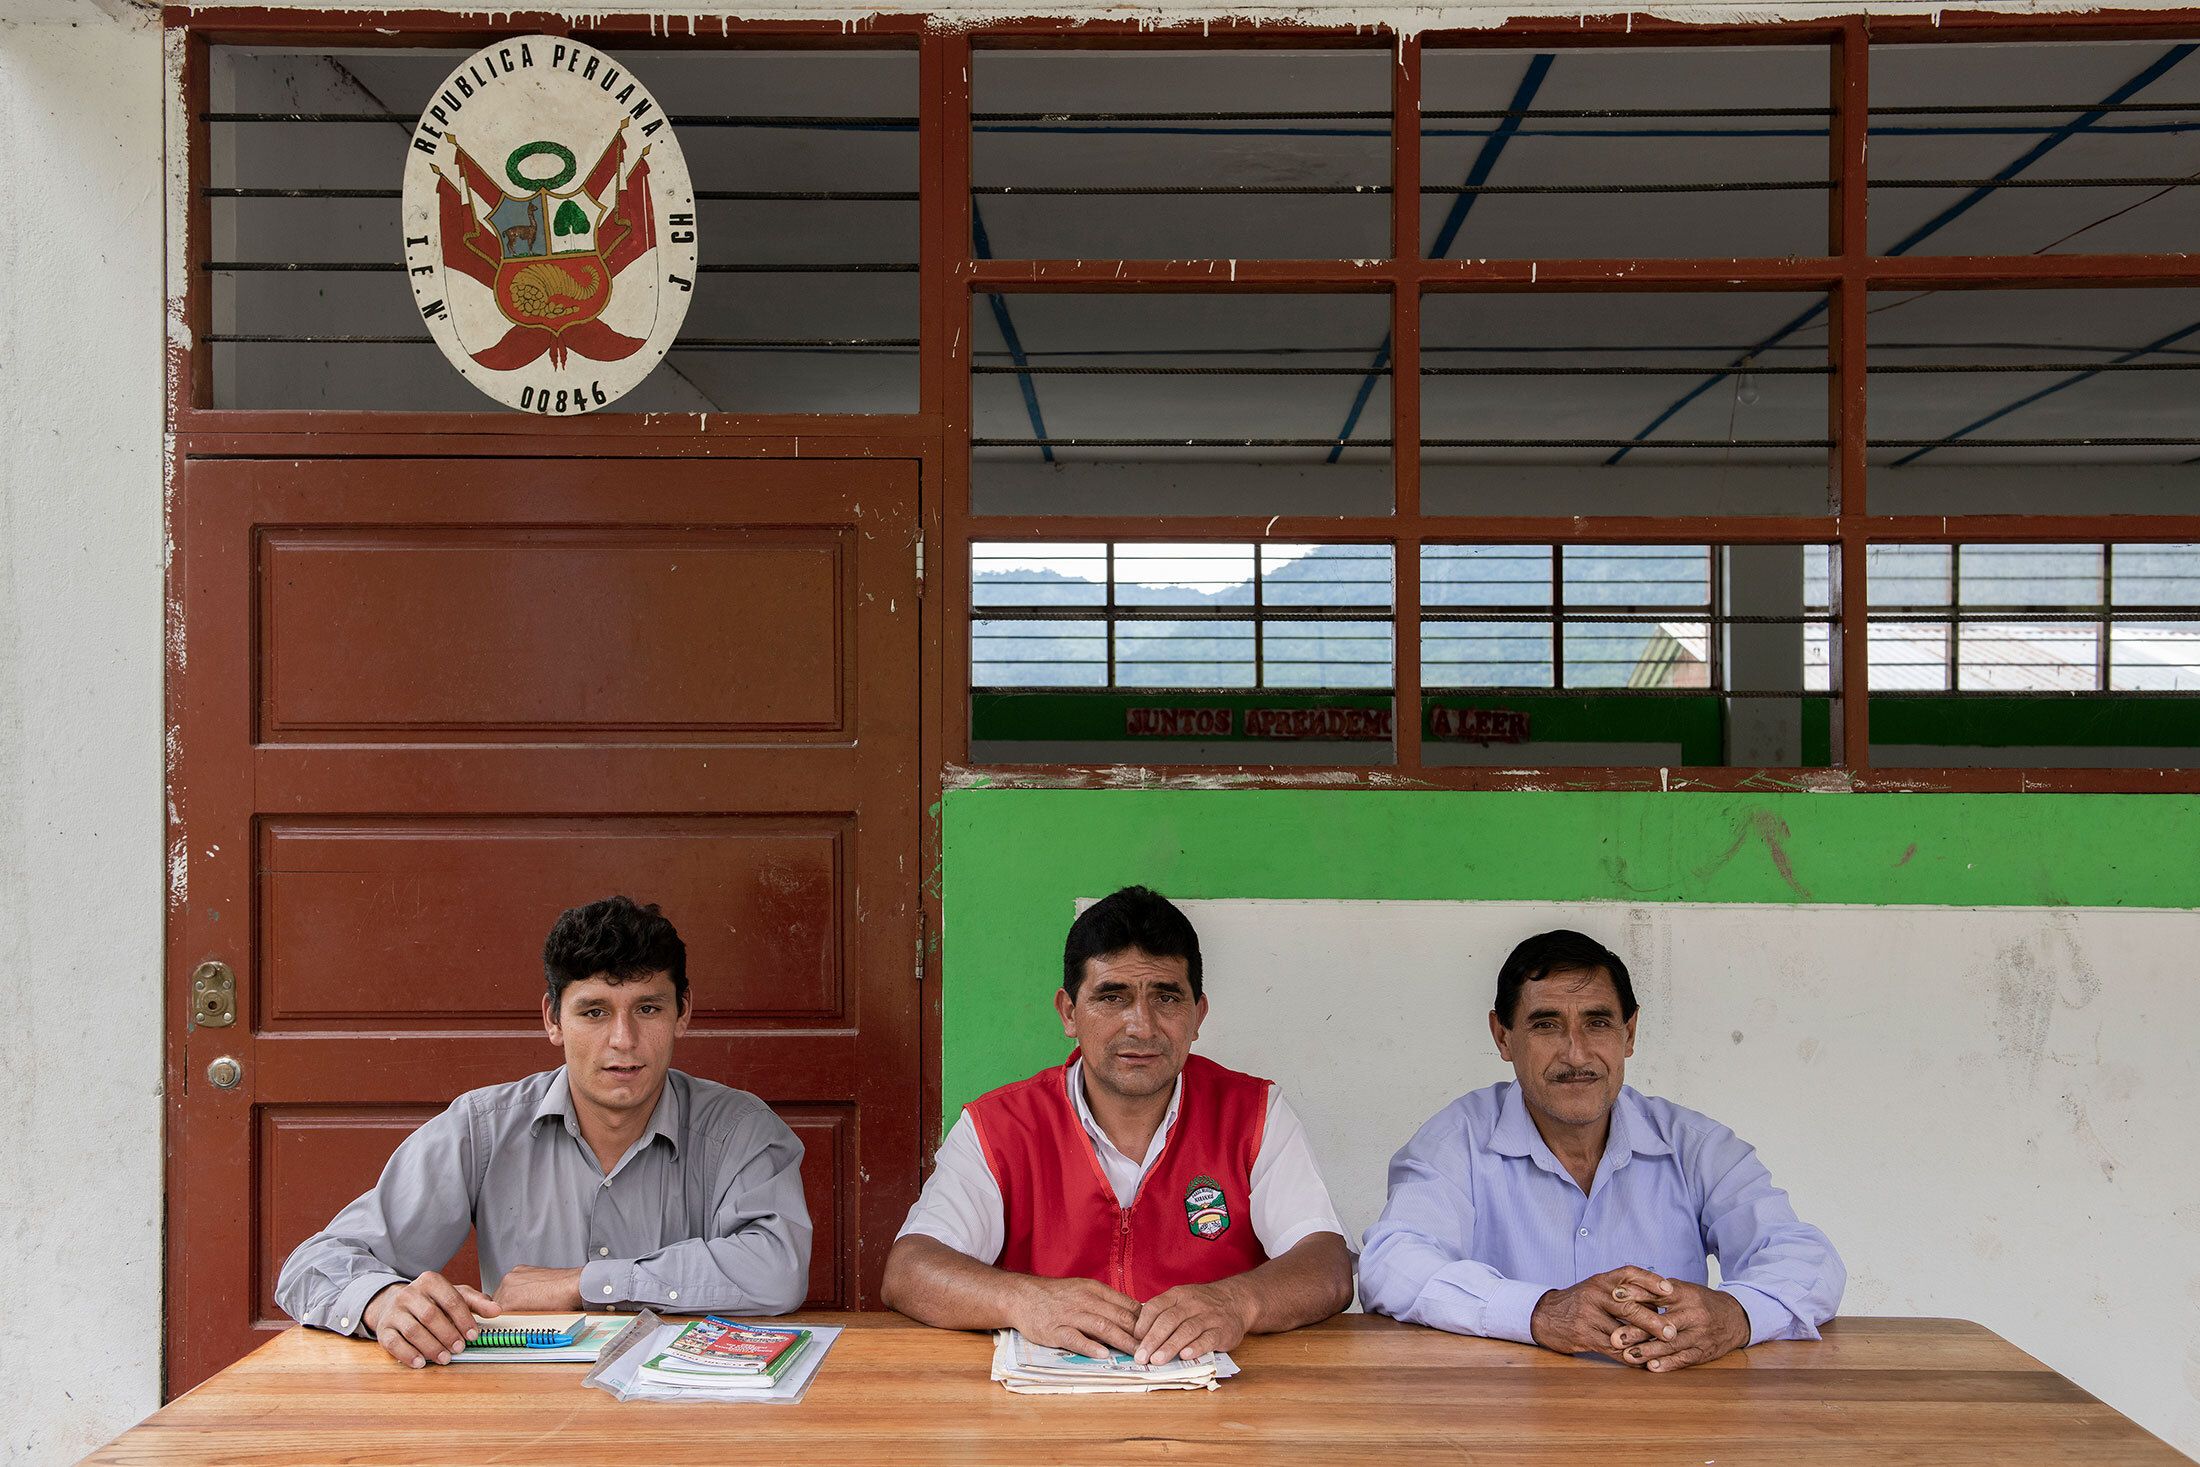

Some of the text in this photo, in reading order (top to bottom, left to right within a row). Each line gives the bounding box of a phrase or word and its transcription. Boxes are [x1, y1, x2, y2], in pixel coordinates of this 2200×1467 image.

[414, 43, 534, 155] REPUBLICA
[520, 381, 607, 413] 00846
[1127, 709, 1527, 736] JUNTOS APRENDEMO A LEER
